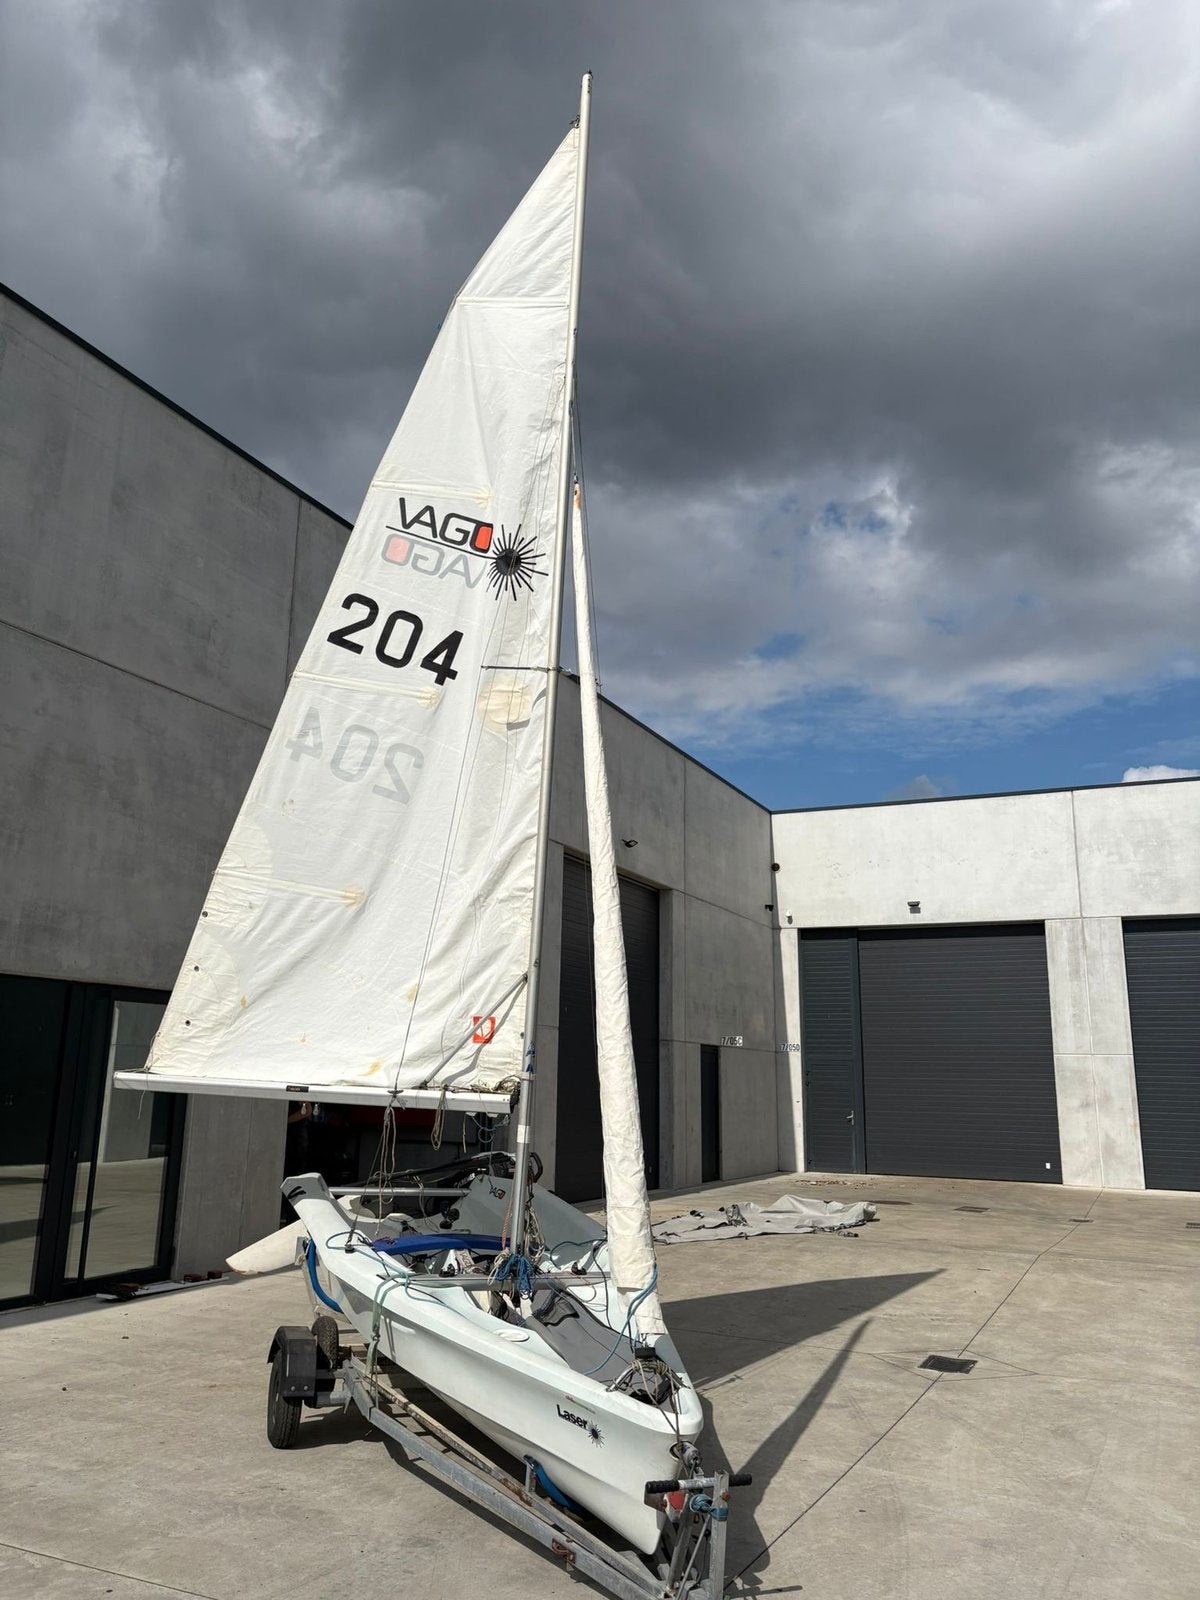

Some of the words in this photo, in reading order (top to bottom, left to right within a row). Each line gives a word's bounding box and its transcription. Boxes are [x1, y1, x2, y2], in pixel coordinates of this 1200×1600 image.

[399, 497, 493, 552] VAGO
[327, 593, 464, 686] 204
[556, 1404, 588, 1430] Laser
